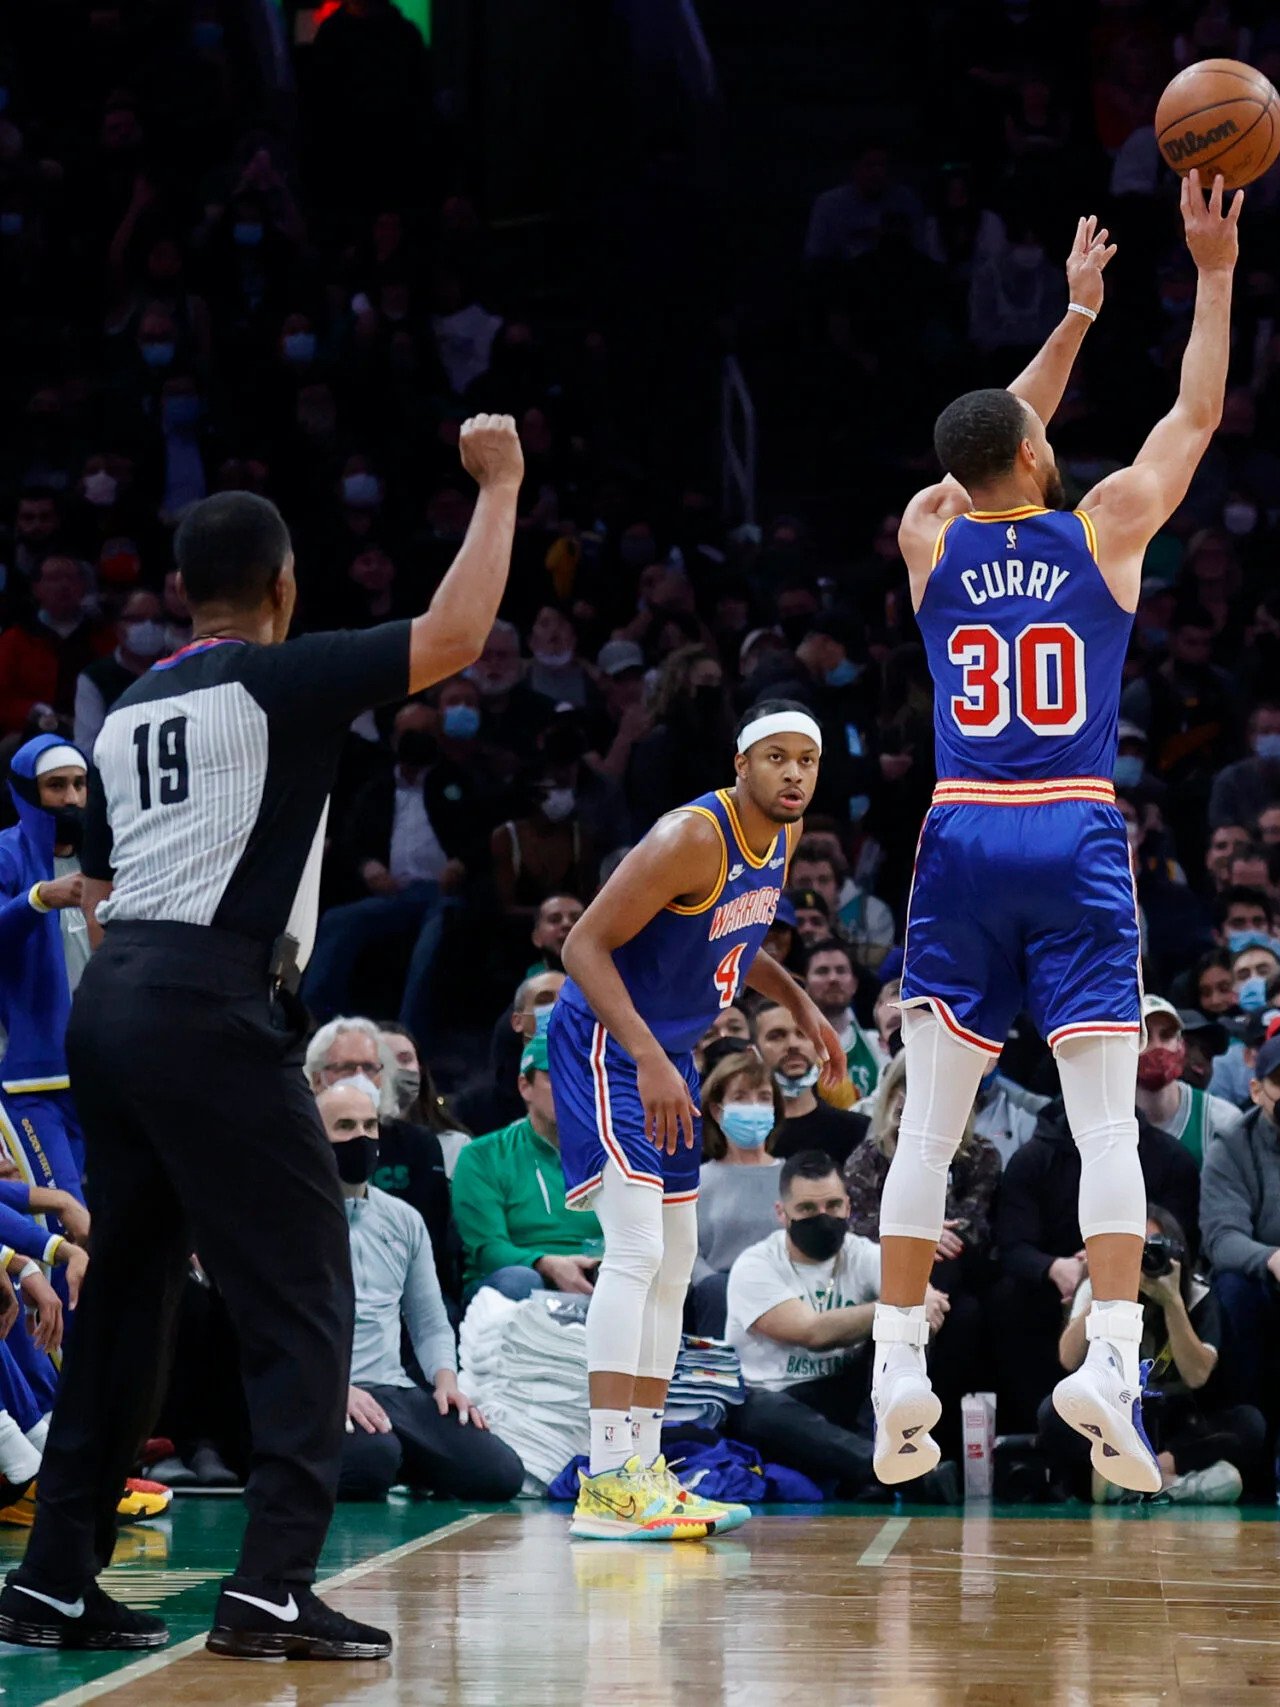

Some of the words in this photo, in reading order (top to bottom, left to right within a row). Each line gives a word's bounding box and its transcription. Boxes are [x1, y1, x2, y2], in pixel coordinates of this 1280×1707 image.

[1164, 119, 1239, 162] Wilson
[960, 559, 1070, 606] CURRY
[947, 622, 1087, 737] 30
[133, 716, 189, 811] 19
[708, 886, 781, 942] WARRIORS
[713, 942, 748, 1009] 4
[22, 1118, 41, 1153] GOLDEN
[37, 1151, 52, 1179] STATE
